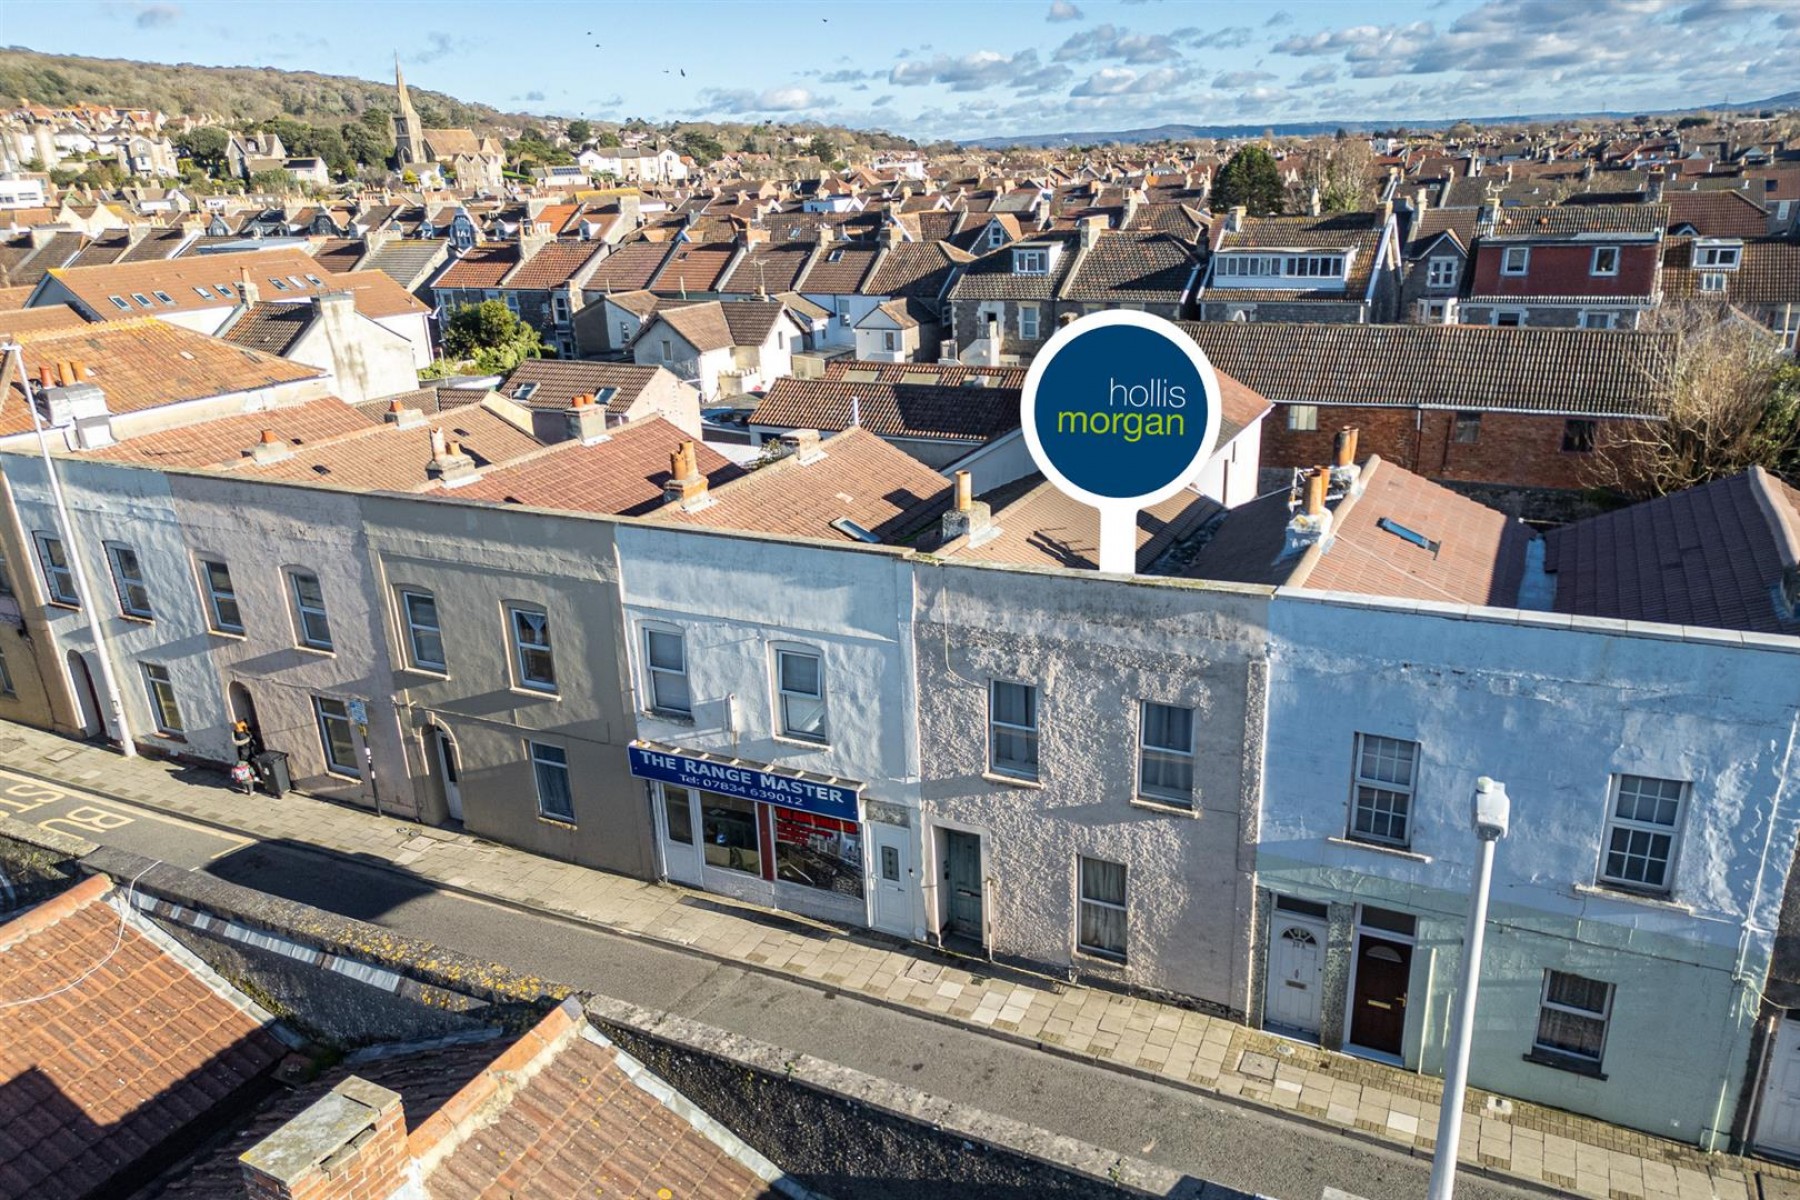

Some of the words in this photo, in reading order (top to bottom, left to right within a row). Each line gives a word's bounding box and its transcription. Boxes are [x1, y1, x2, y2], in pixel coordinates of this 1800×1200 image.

[640, 750, 677, 770] THE
[685, 759, 752, 785] RANGE
[760, 775, 844, 804] MASTER
[679, 774, 700, 785] Tel:
[703, 779, 746, 793] 07834
[750, 788, 804, 805] 639012
[37, 807, 136, 841] BU
